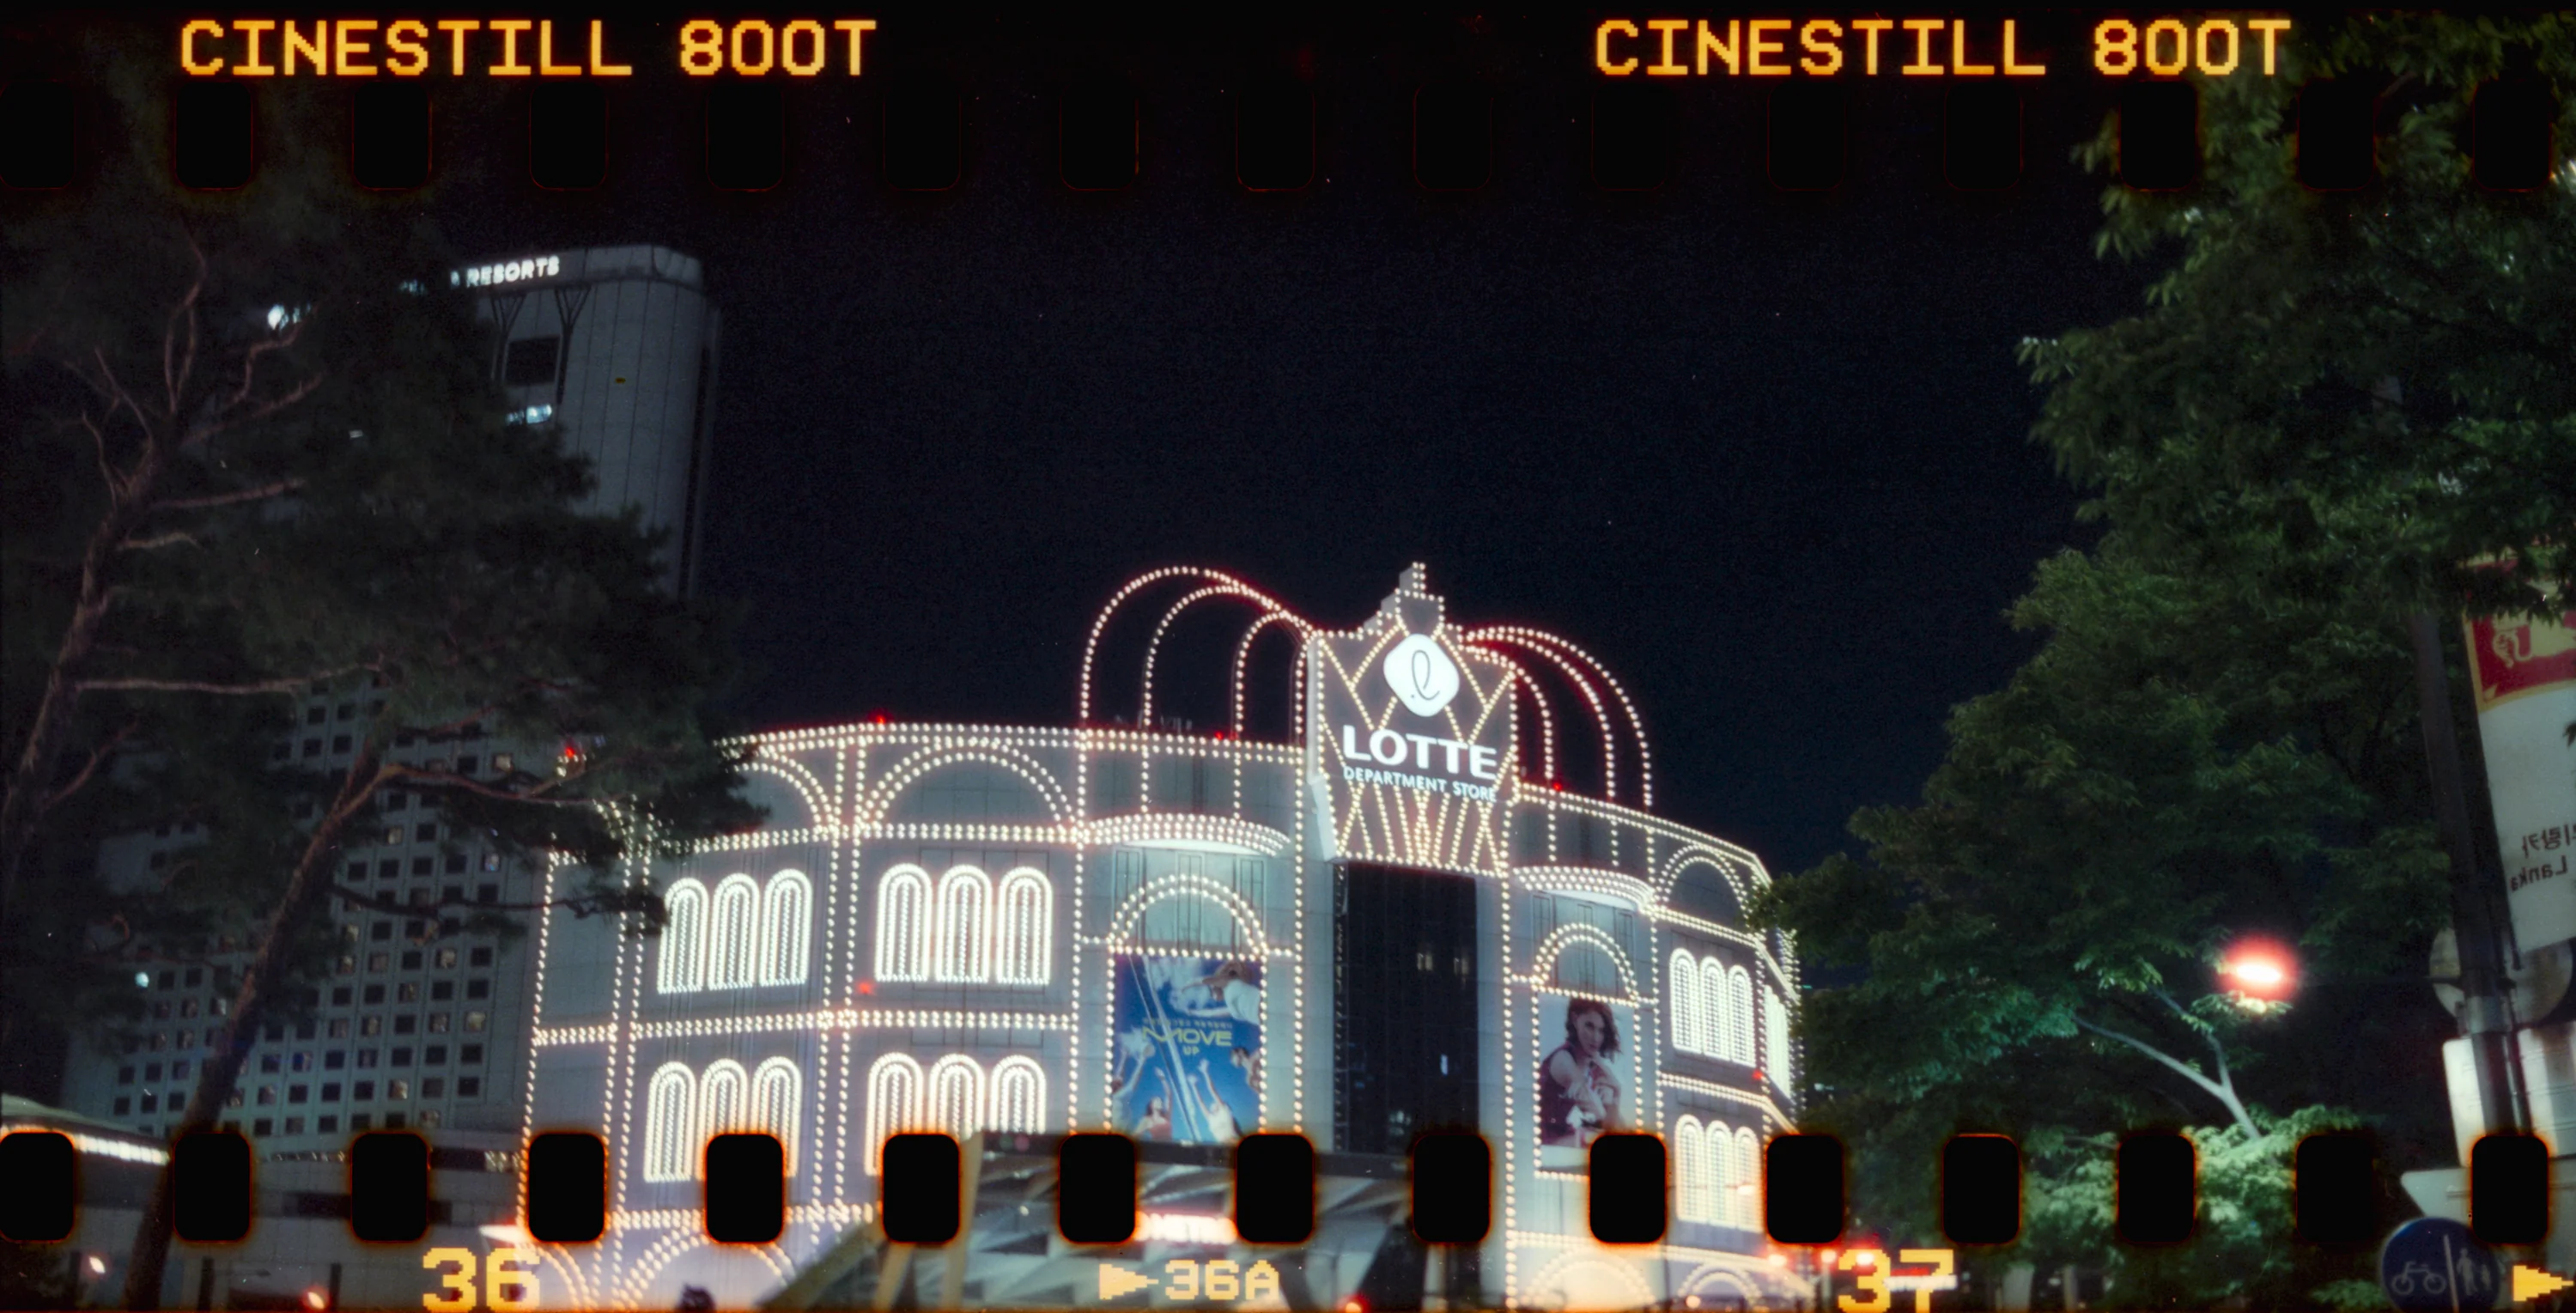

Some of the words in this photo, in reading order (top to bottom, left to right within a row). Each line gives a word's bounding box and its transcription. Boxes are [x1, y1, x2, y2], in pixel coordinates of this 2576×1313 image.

[467, 255, 559, 288] RESORTS
[1343, 724, 1498, 780] LOTTE
[1343, 765, 1448, 792] DEPARTMENT
[1452, 780, 1497, 803] STORE
[1142, 1026, 1232, 1047] MOVE
[1182, 1046, 1200, 1055] UP
